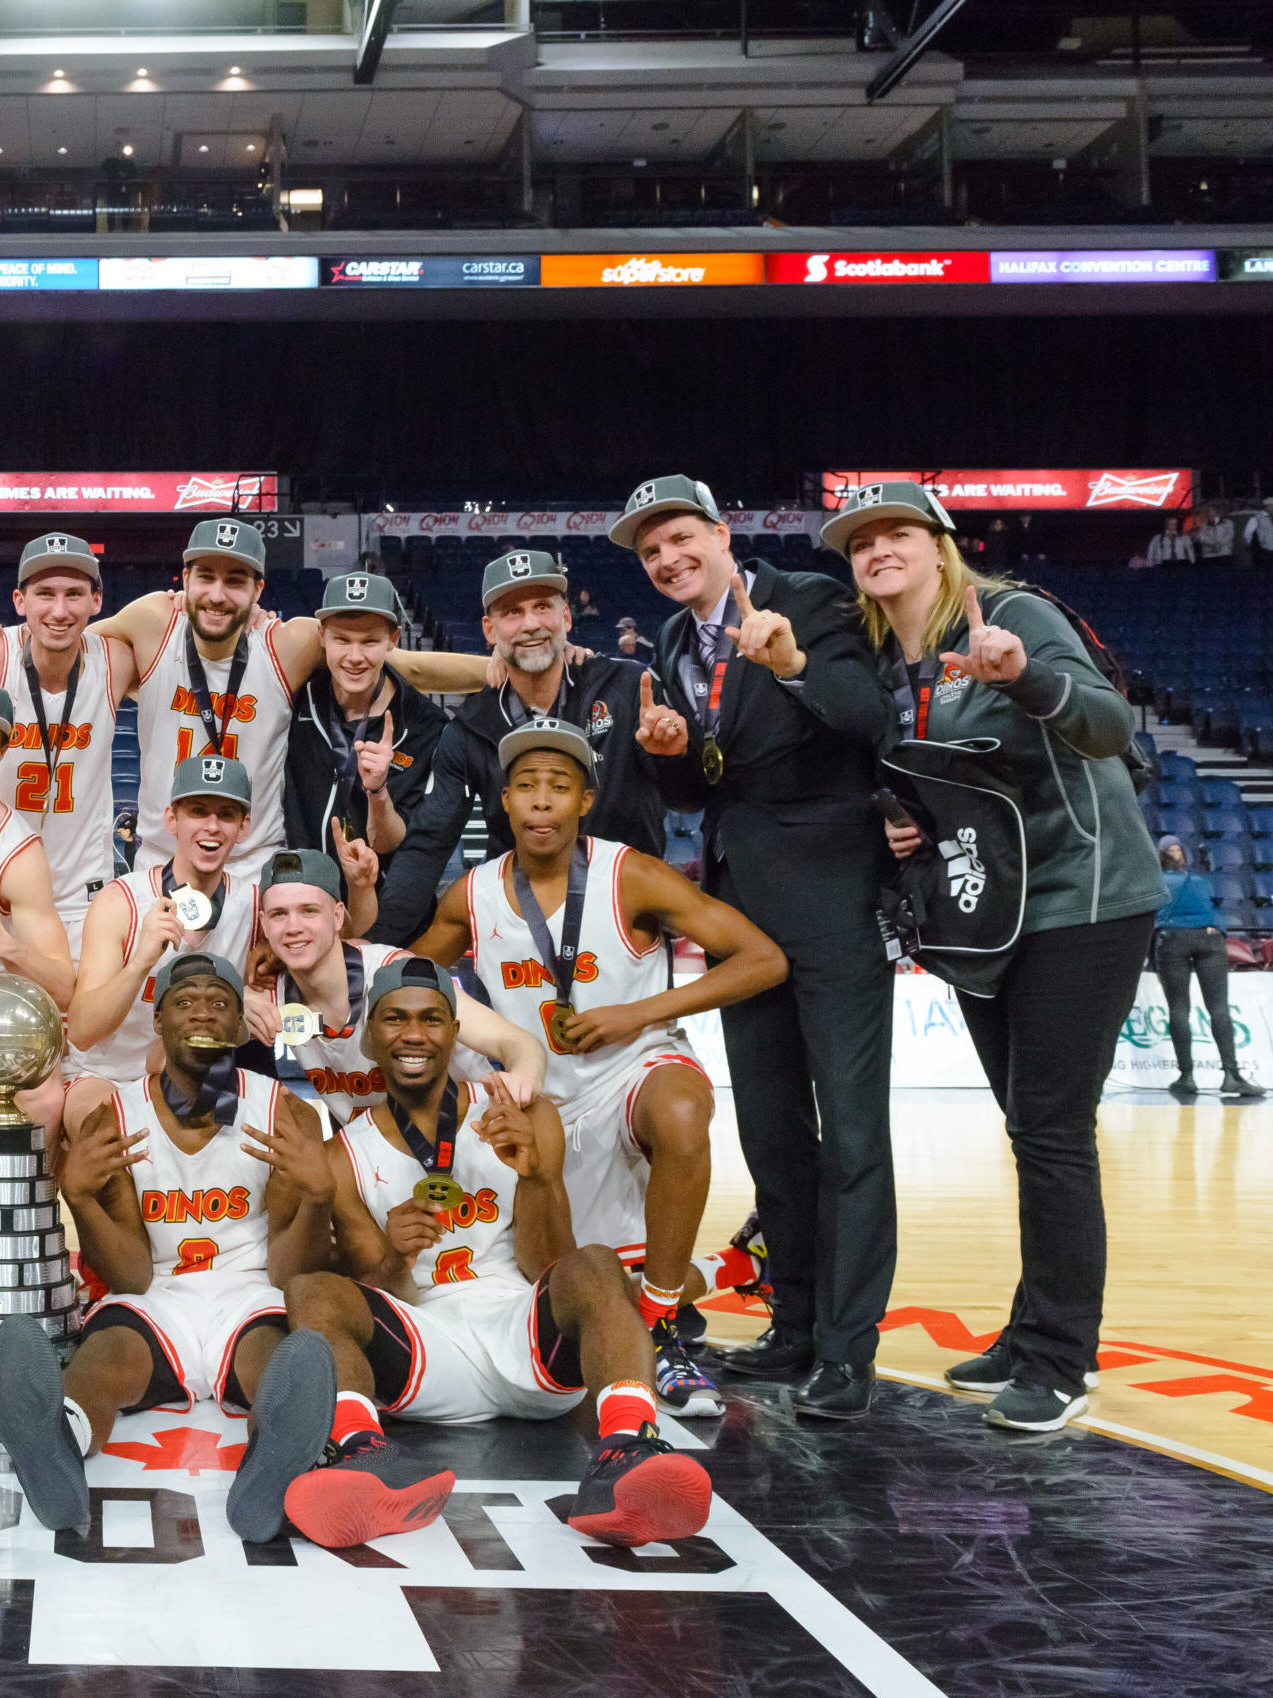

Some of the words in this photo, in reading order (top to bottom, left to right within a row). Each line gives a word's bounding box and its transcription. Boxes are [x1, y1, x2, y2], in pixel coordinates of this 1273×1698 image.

[31, 263, 45, 274] OF
[47, 262, 78, 274] MIND.
[345, 262, 422, 275] CARSTAR
[462, 262, 525, 273] carstar.ca
[602, 265, 706, 284] superstore
[834, 259, 944, 276] Scotiabank
[999, 262, 1057, 274] HALIFAX
[1060, 260, 1153, 273] CONVENTION
[1156, 259, 1210, 272] CENTRE
[44, 487, 79, 499] ARE
[81, 486, 156, 500] WAITING.
[952, 484, 988, 497] ARE
[990, 483, 1068, 497] WAITING.
[253, 520, 279, 538] 23
[419, 513, 460, 532] Q104
[468, 512, 508, 531] Q104
[517, 511, 557, 530] Q104
[566, 511, 607, 530] Q104
[763, 510, 804, 530] Q104
[935, 675, 972, 697] DINOS
[170, 684, 258, 723] DINOS
[7, 721, 94, 751] DINOS
[15, 761, 75, 813] 21
[957, 827, 986, 914] adidas
[501, 952, 598, 988] DINS
[308, 1067, 387, 1098] DINOS
[142, 1186, 251, 1224] DINOS
[434, 1187, 499, 1233] NOS
